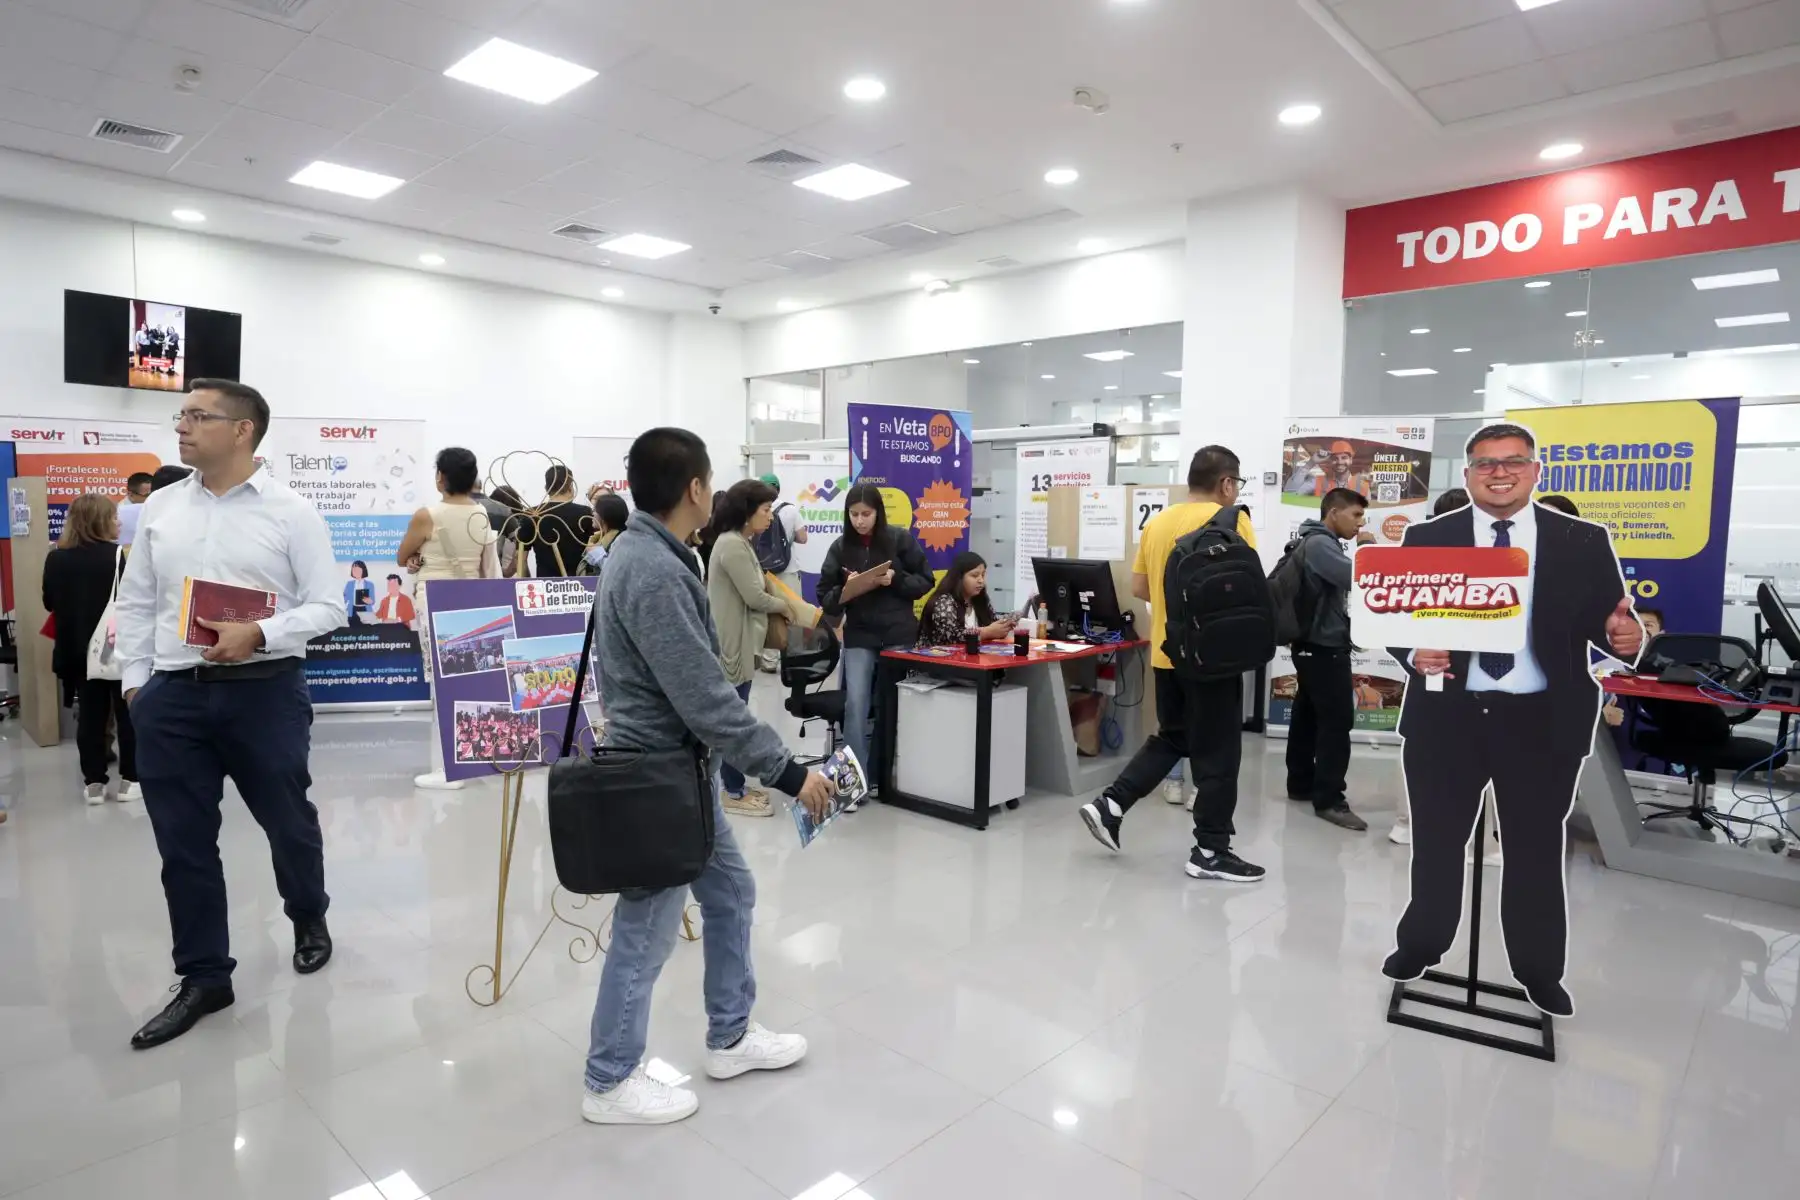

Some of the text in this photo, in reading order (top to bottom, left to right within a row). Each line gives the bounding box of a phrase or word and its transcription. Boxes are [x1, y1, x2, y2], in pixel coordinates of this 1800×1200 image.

[1396, 213, 1543, 269] TODO
[1562, 179, 1748, 246] PARA
[879, 417, 951, 438] EN Veta BPO
[880, 440, 930, 451] TE ESTAMOS
[1374, 452, 1405, 462] ÚNETE A
[1540, 441, 1694, 466] ¡Estamos
[900, 454, 942, 464] BUSCANDO
[101, 465, 117, 474] tus
[1373, 464, 1408, 472] NUESTRO
[1031, 471, 1091, 492] 13 servicios
[1376, 473, 1404, 481] EQUIPO
[1538, 462, 1693, 493] CONTRATANDO!
[289, 480, 377, 490] Ofertas laborales
[316, 491, 357, 502] trabajar
[317, 501, 351, 511] Estado
[1623, 500, 1670, 509] vacantes
[1672, 500, 1686, 508] en
[1582, 509, 1608, 519] sitios
[916, 520, 966, 529] OPORTUNIDAD
[1623, 521, 1669, 531] Bumeran,
[1622, 533, 1628, 541] y
[1630, 531, 1676, 541] LinkedIn.
[1358, 570, 1466, 588] Mi primera
[545, 581, 580, 594] Centro
[547, 594, 560, 606] de
[1365, 582, 1516, 609] CHAMBA
[1416, 609, 1513, 621] ¡Ven y encuéntrala!
[331, 633, 379, 642] Accede desde
